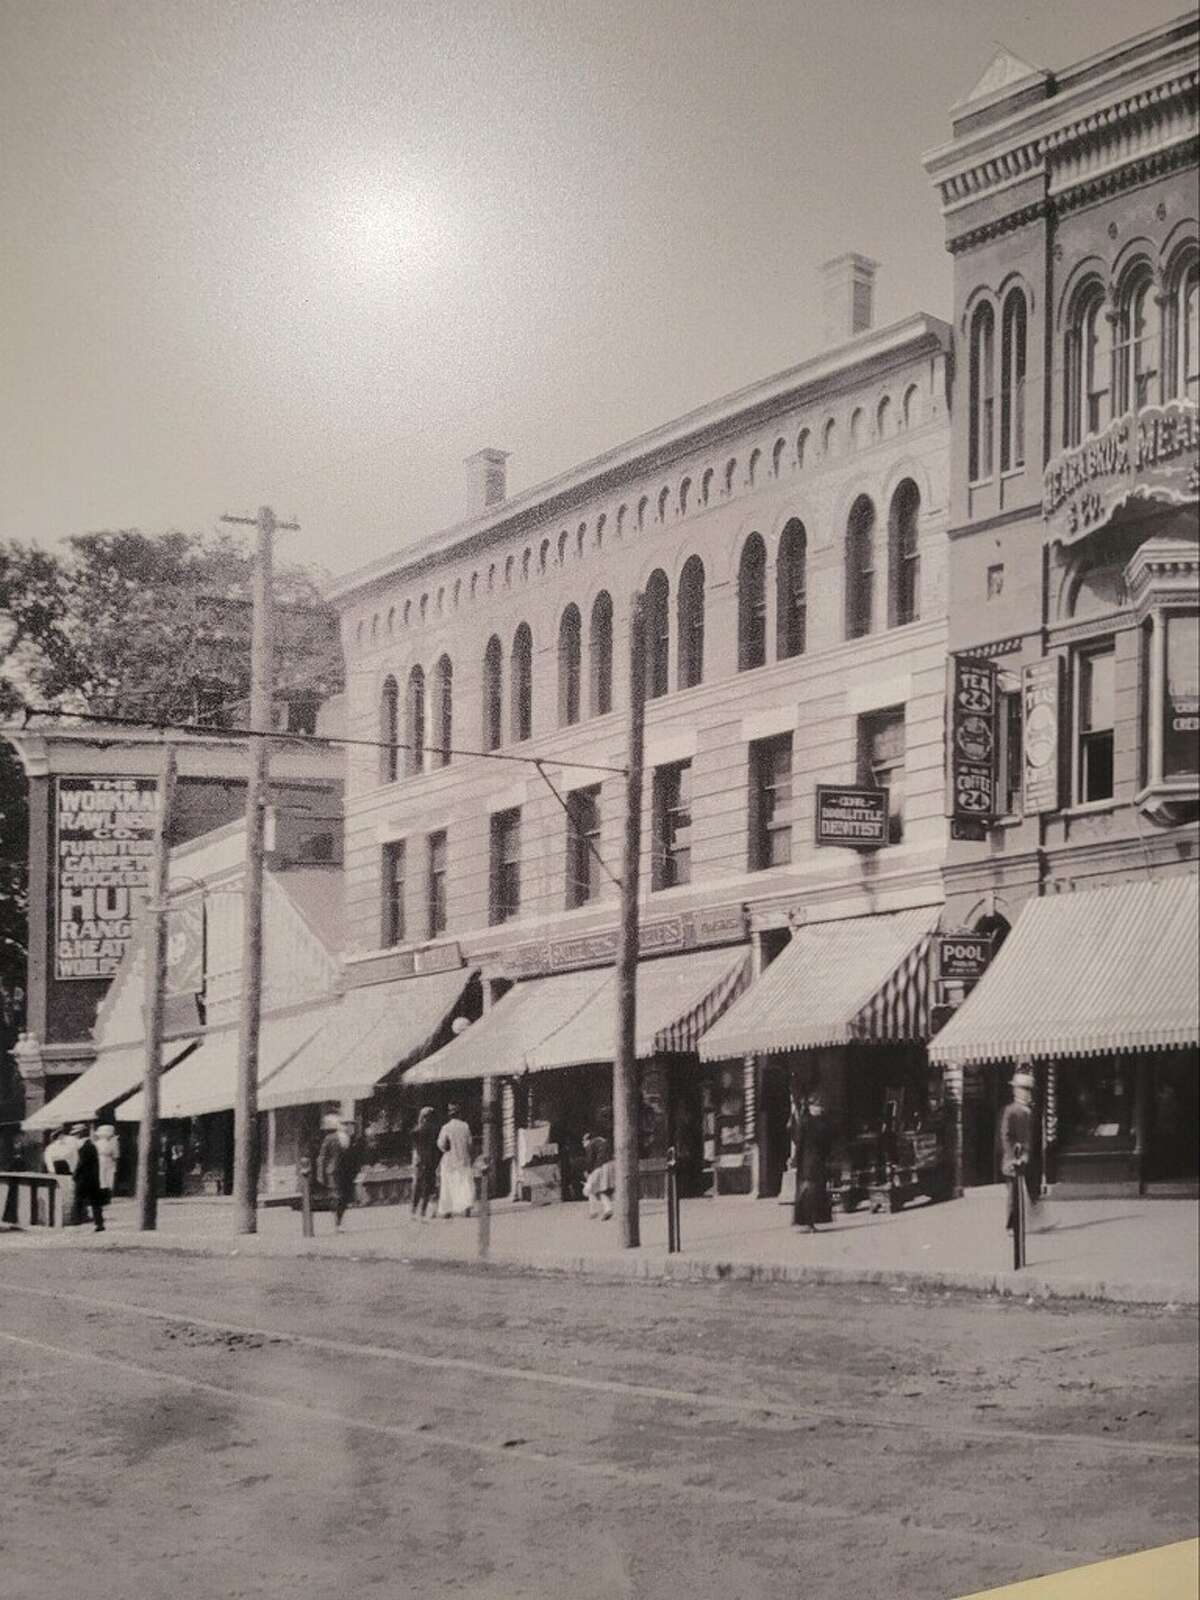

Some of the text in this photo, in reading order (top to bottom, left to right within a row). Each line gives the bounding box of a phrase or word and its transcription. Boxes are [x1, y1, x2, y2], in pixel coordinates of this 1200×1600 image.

[959, 673, 991, 694] TEA
[90, 780, 137, 790] THE
[964, 792, 988, 809] 24
[821, 820, 882, 836] DENTIST
[61, 921, 131, 939] RANG
[943, 944, 985, 963] POOL
